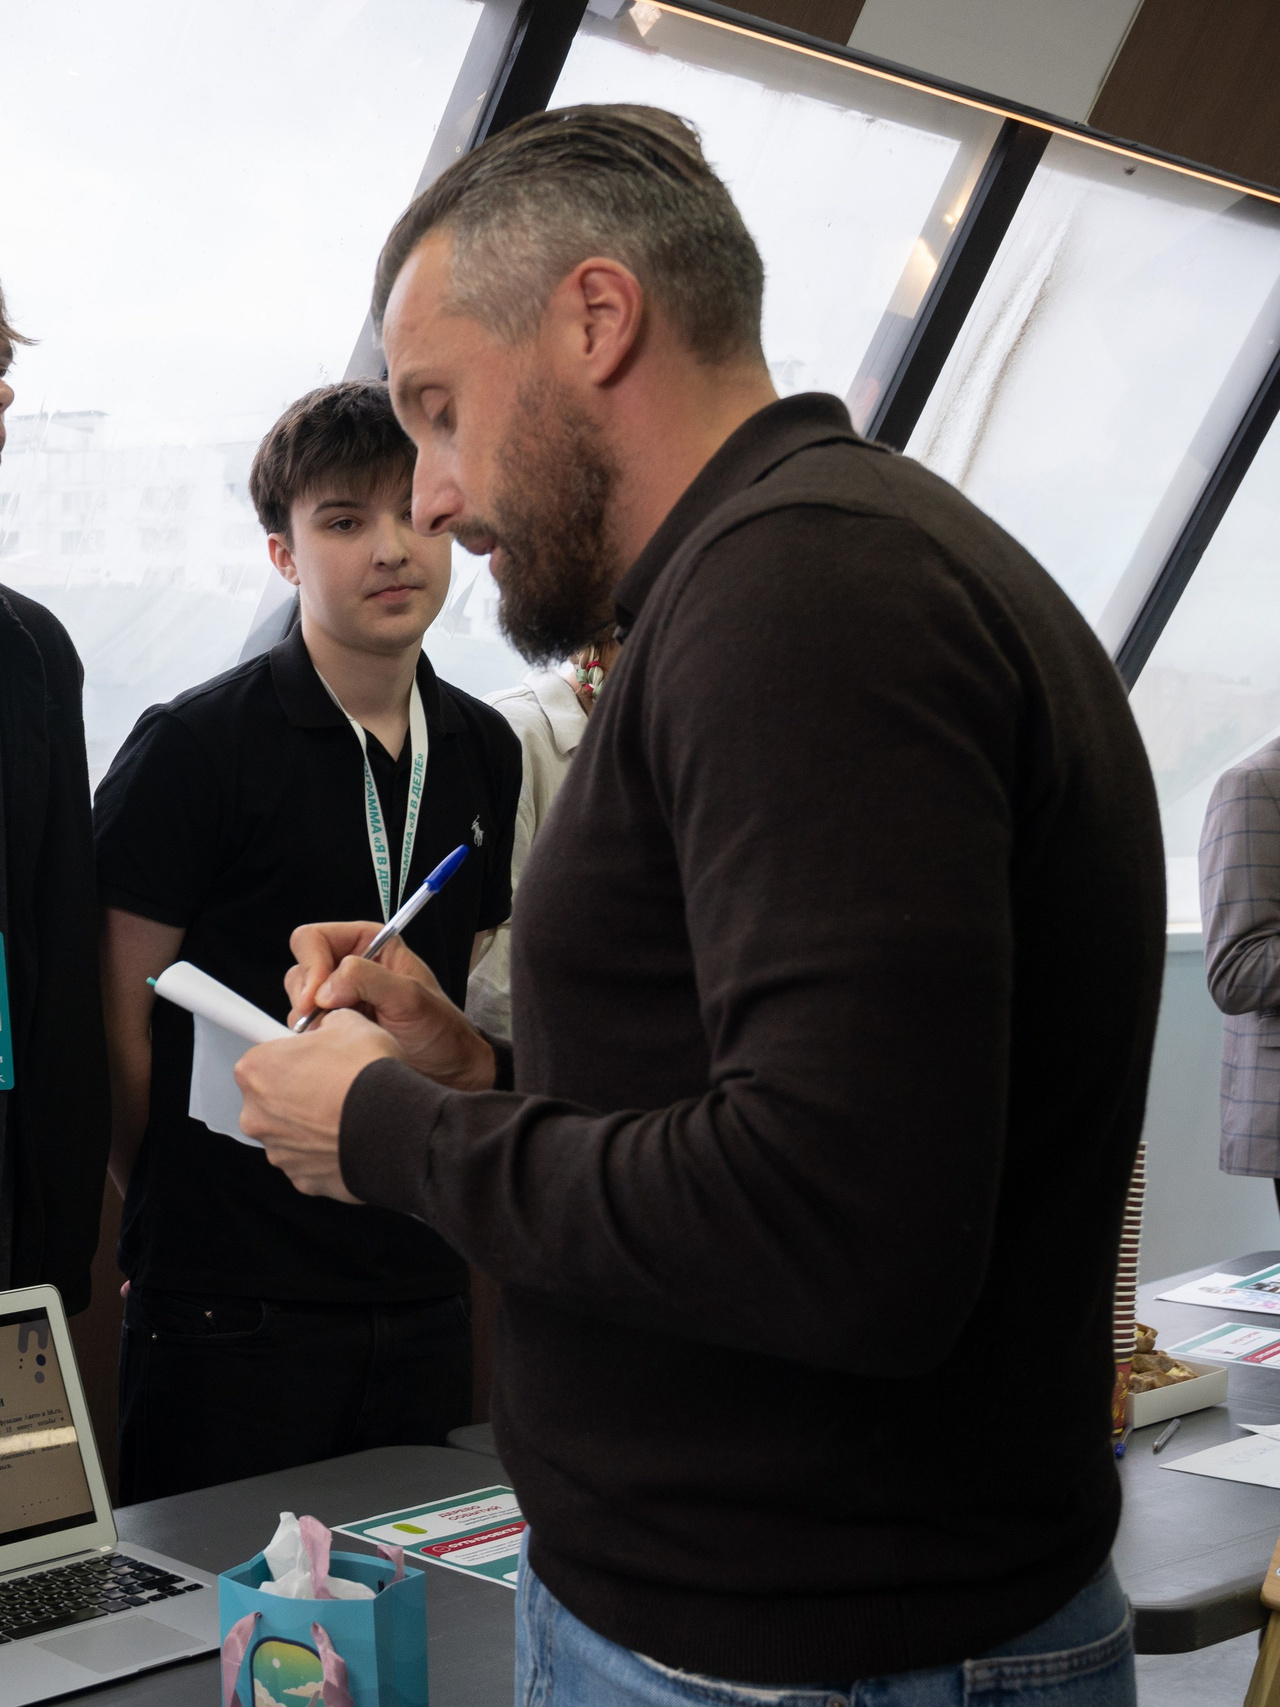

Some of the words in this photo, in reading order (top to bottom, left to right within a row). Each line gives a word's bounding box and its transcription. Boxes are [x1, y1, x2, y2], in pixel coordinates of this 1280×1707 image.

[410, 752, 424, 800] ДЕЛЕ»
[364, 762, 382, 834] ОГРАММА
[409, 800, 418, 809] В
[409, 811, 417, 828] «Я
[373, 836, 385, 853] «Я
[376, 857, 387, 865] В
[377, 868, 389, 914] ДЕЛЕ»
